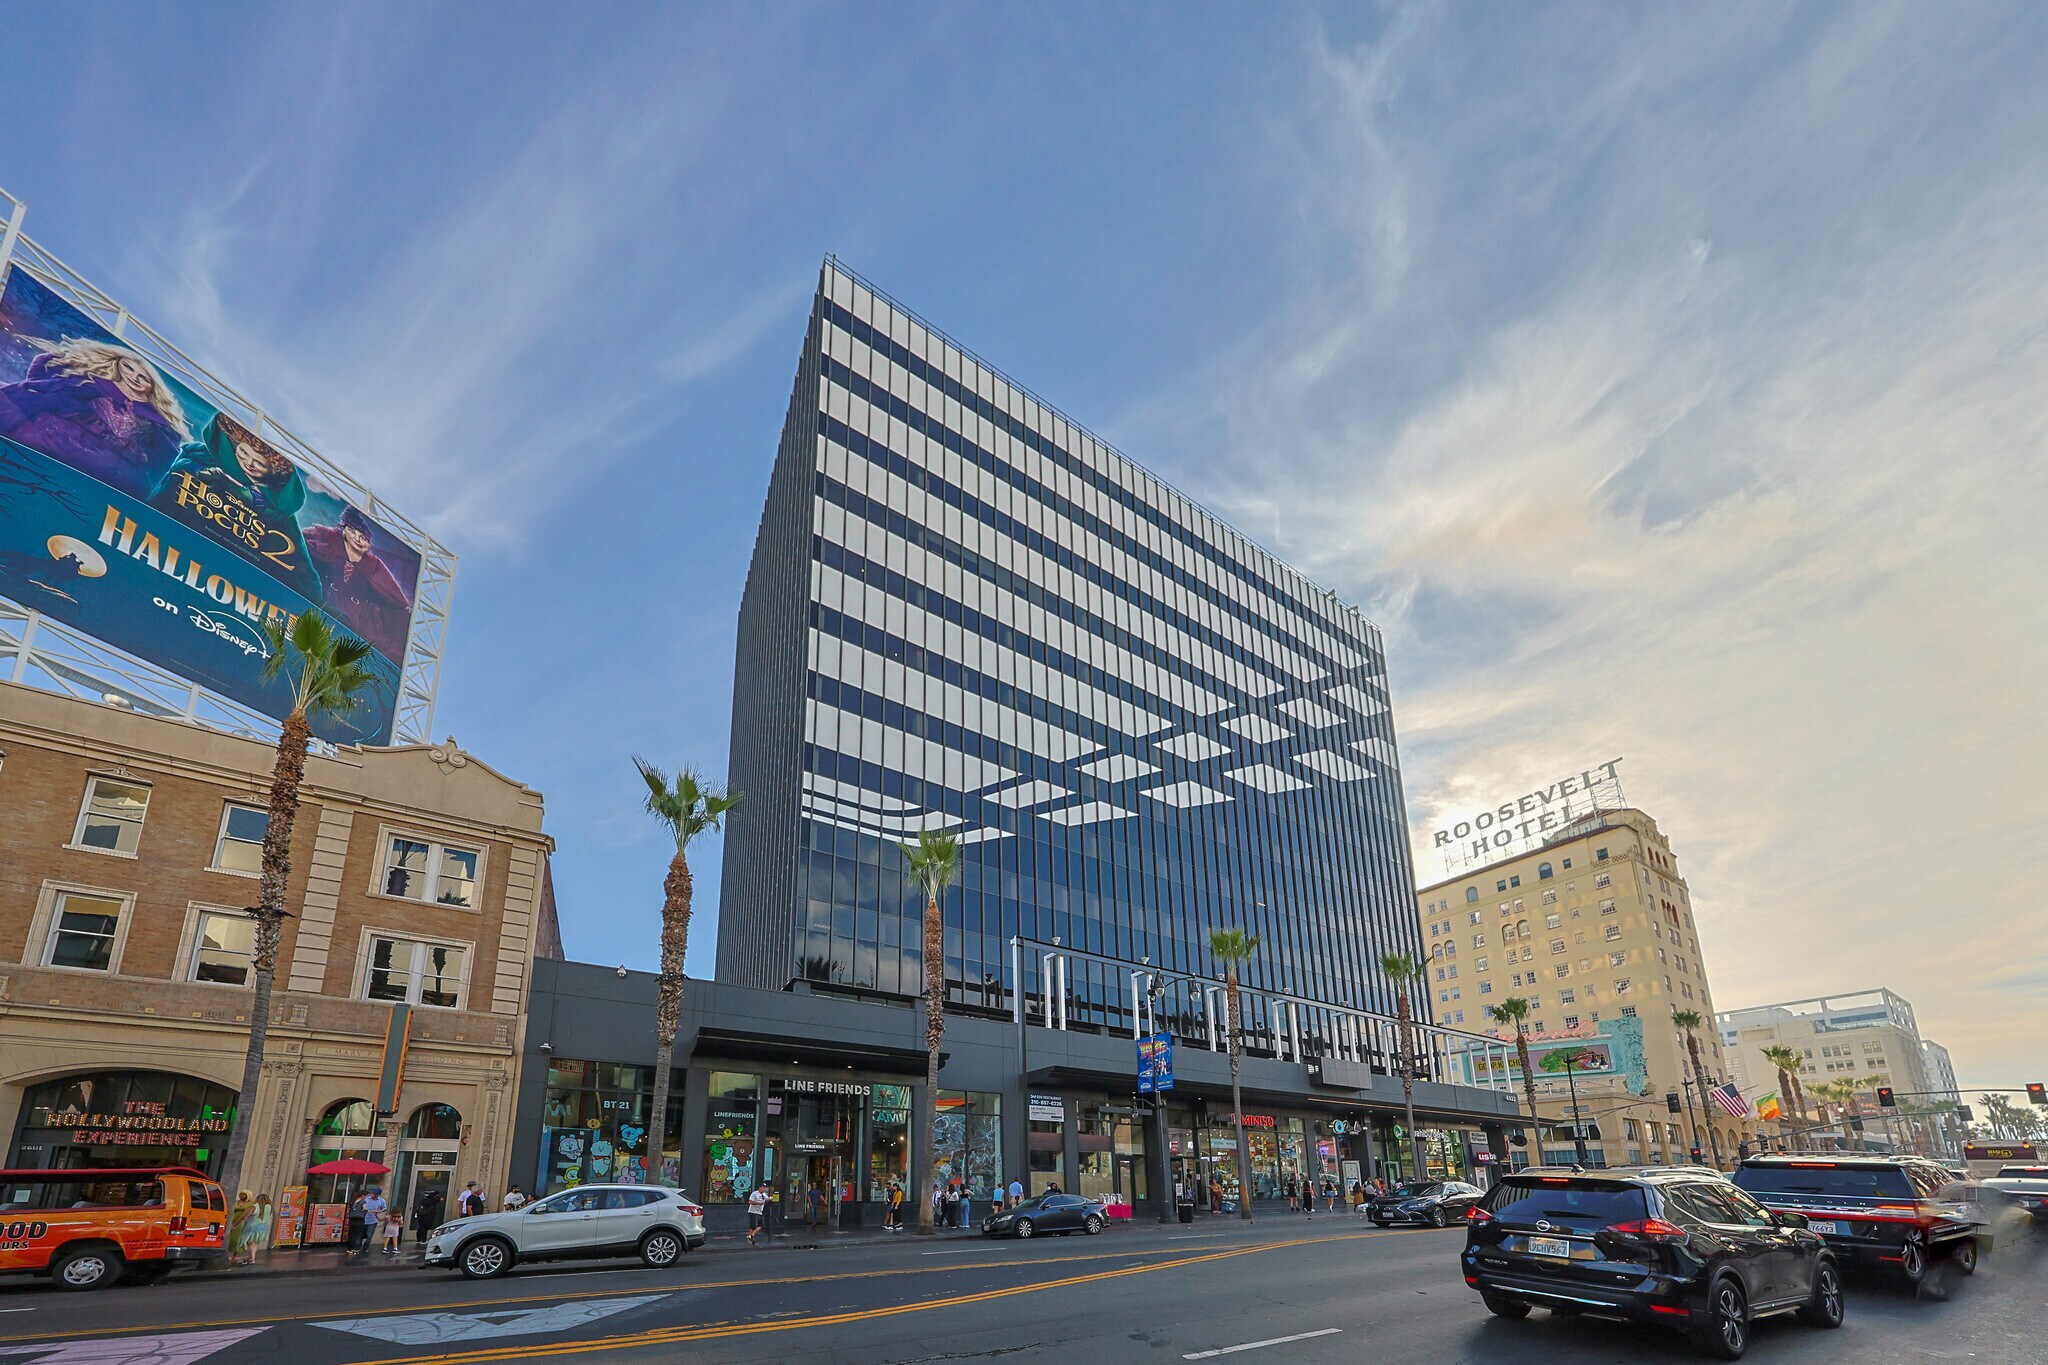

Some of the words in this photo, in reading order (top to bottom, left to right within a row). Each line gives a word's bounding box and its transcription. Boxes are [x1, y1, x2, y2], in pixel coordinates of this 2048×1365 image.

[172, 469, 266, 536] HOCUS
[175, 485, 260, 549] POCUS
[260, 529, 296, 571] 2
[97, 504, 300, 642] HALLOWE
[152, 596, 179, 615] on
[1433, 756, 1623, 848] ROOSEVELT
[1471, 805, 1583, 859] HOTEL
[784, 1079, 814, 1092] LINE
[817, 1082, 871, 1096] FRIENDS
[124, 1101, 167, 1116] THE
[603, 1100, 617, 1109] BT
[619, 1101, 630, 1110] 21
[45, 1113, 230, 1132] HOLLYWOODLAND
[1241, 1115, 1275, 1127] MINISO
[72, 1130, 202, 1146] EXPERIENCE
[0, 1240, 29, 1251] URS
[1531, 1243, 1567, 1257] 9CHV567
